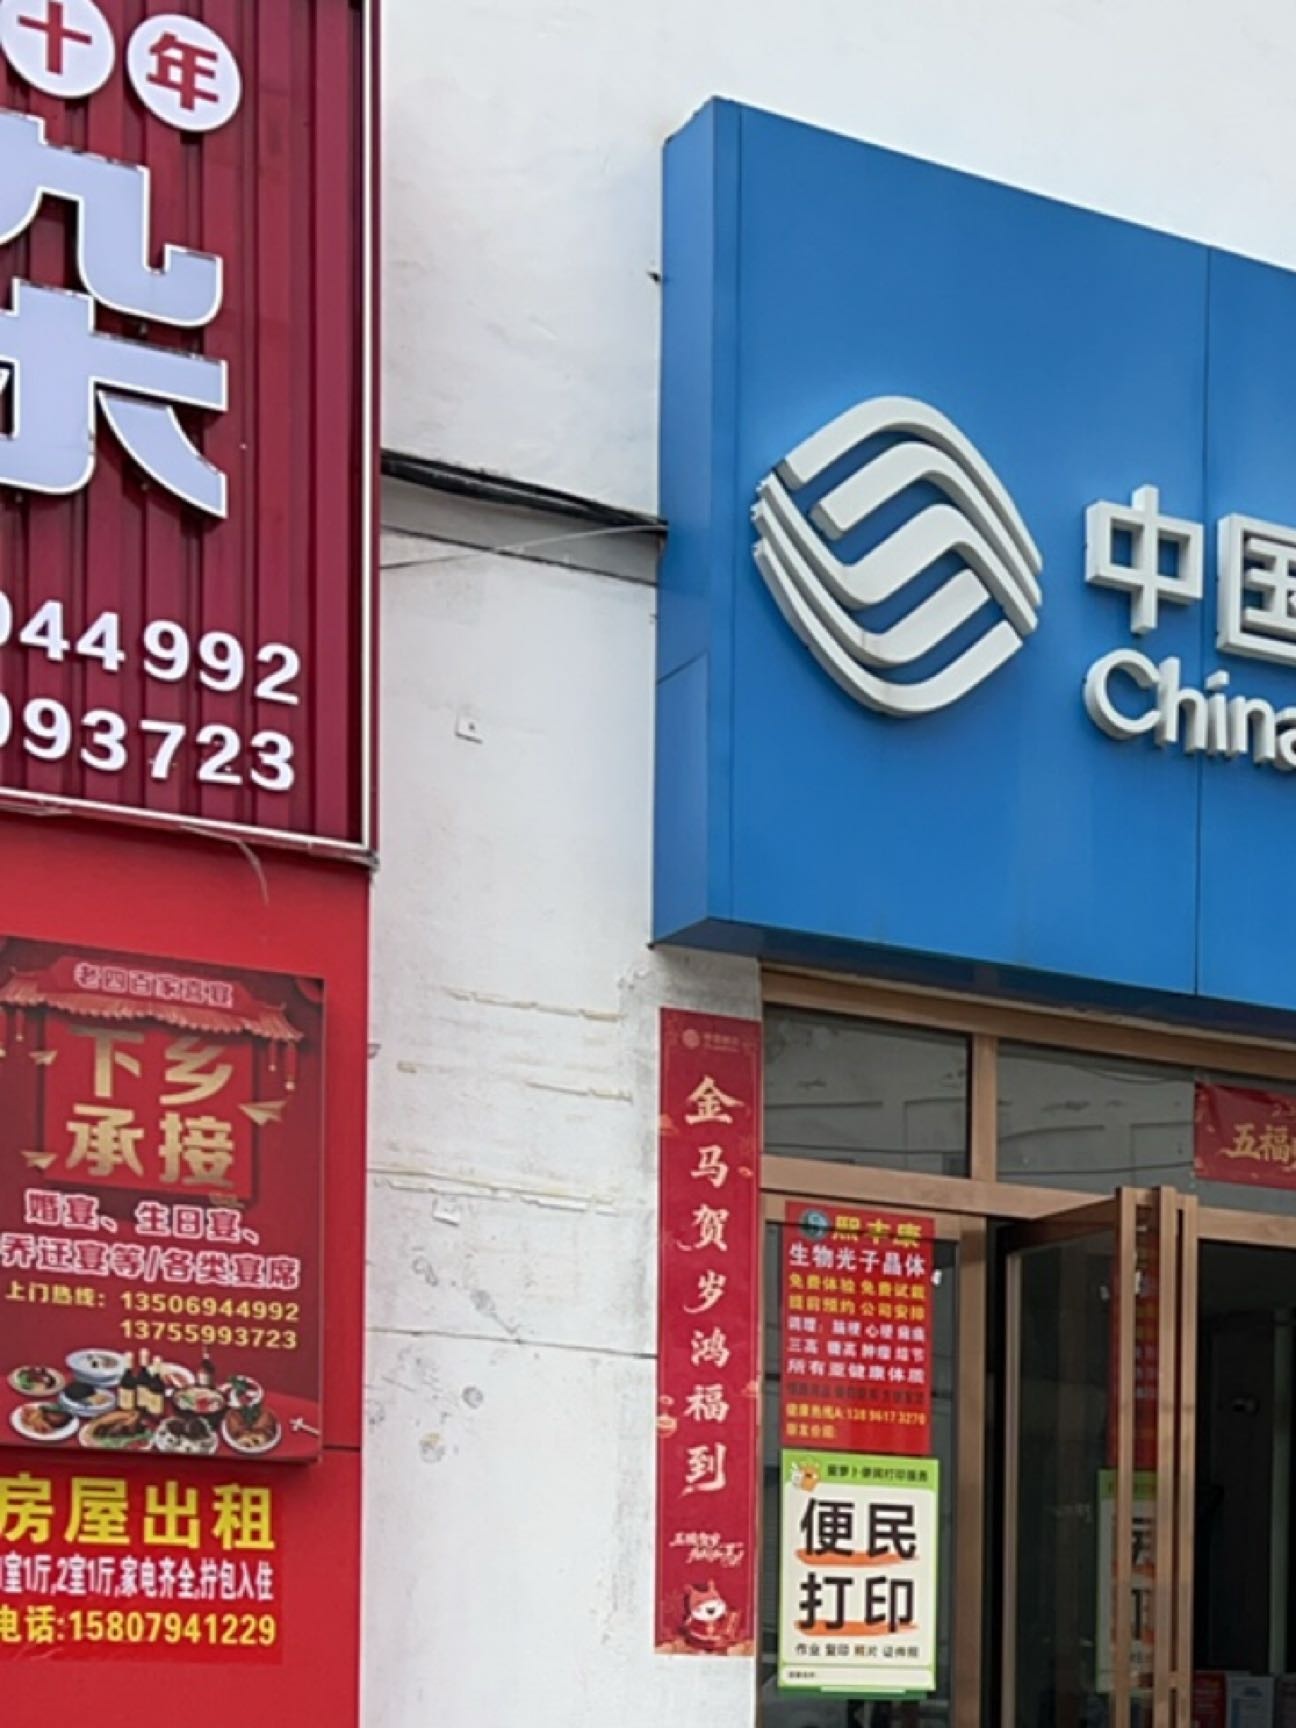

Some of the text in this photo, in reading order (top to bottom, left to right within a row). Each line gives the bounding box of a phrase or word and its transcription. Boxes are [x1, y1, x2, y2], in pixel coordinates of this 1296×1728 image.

[0, 592, 300, 705] 44992
[0, 695, 296, 792] 93723
[68, 1024, 234, 1106] 下乡
[66, 1104, 235, 1189] 承接
[684, 1075, 742, 1497] 金马贺岁鸿福到
[789, 1240, 925, 1278] 生物光子晶体
[120, 1319, 297, 1350] 13755993723
[0, 1473, 275, 1551] 房屋出租
[799, 1497, 917, 1561] 便民
[799, 1571, 914, 1634] 打印
